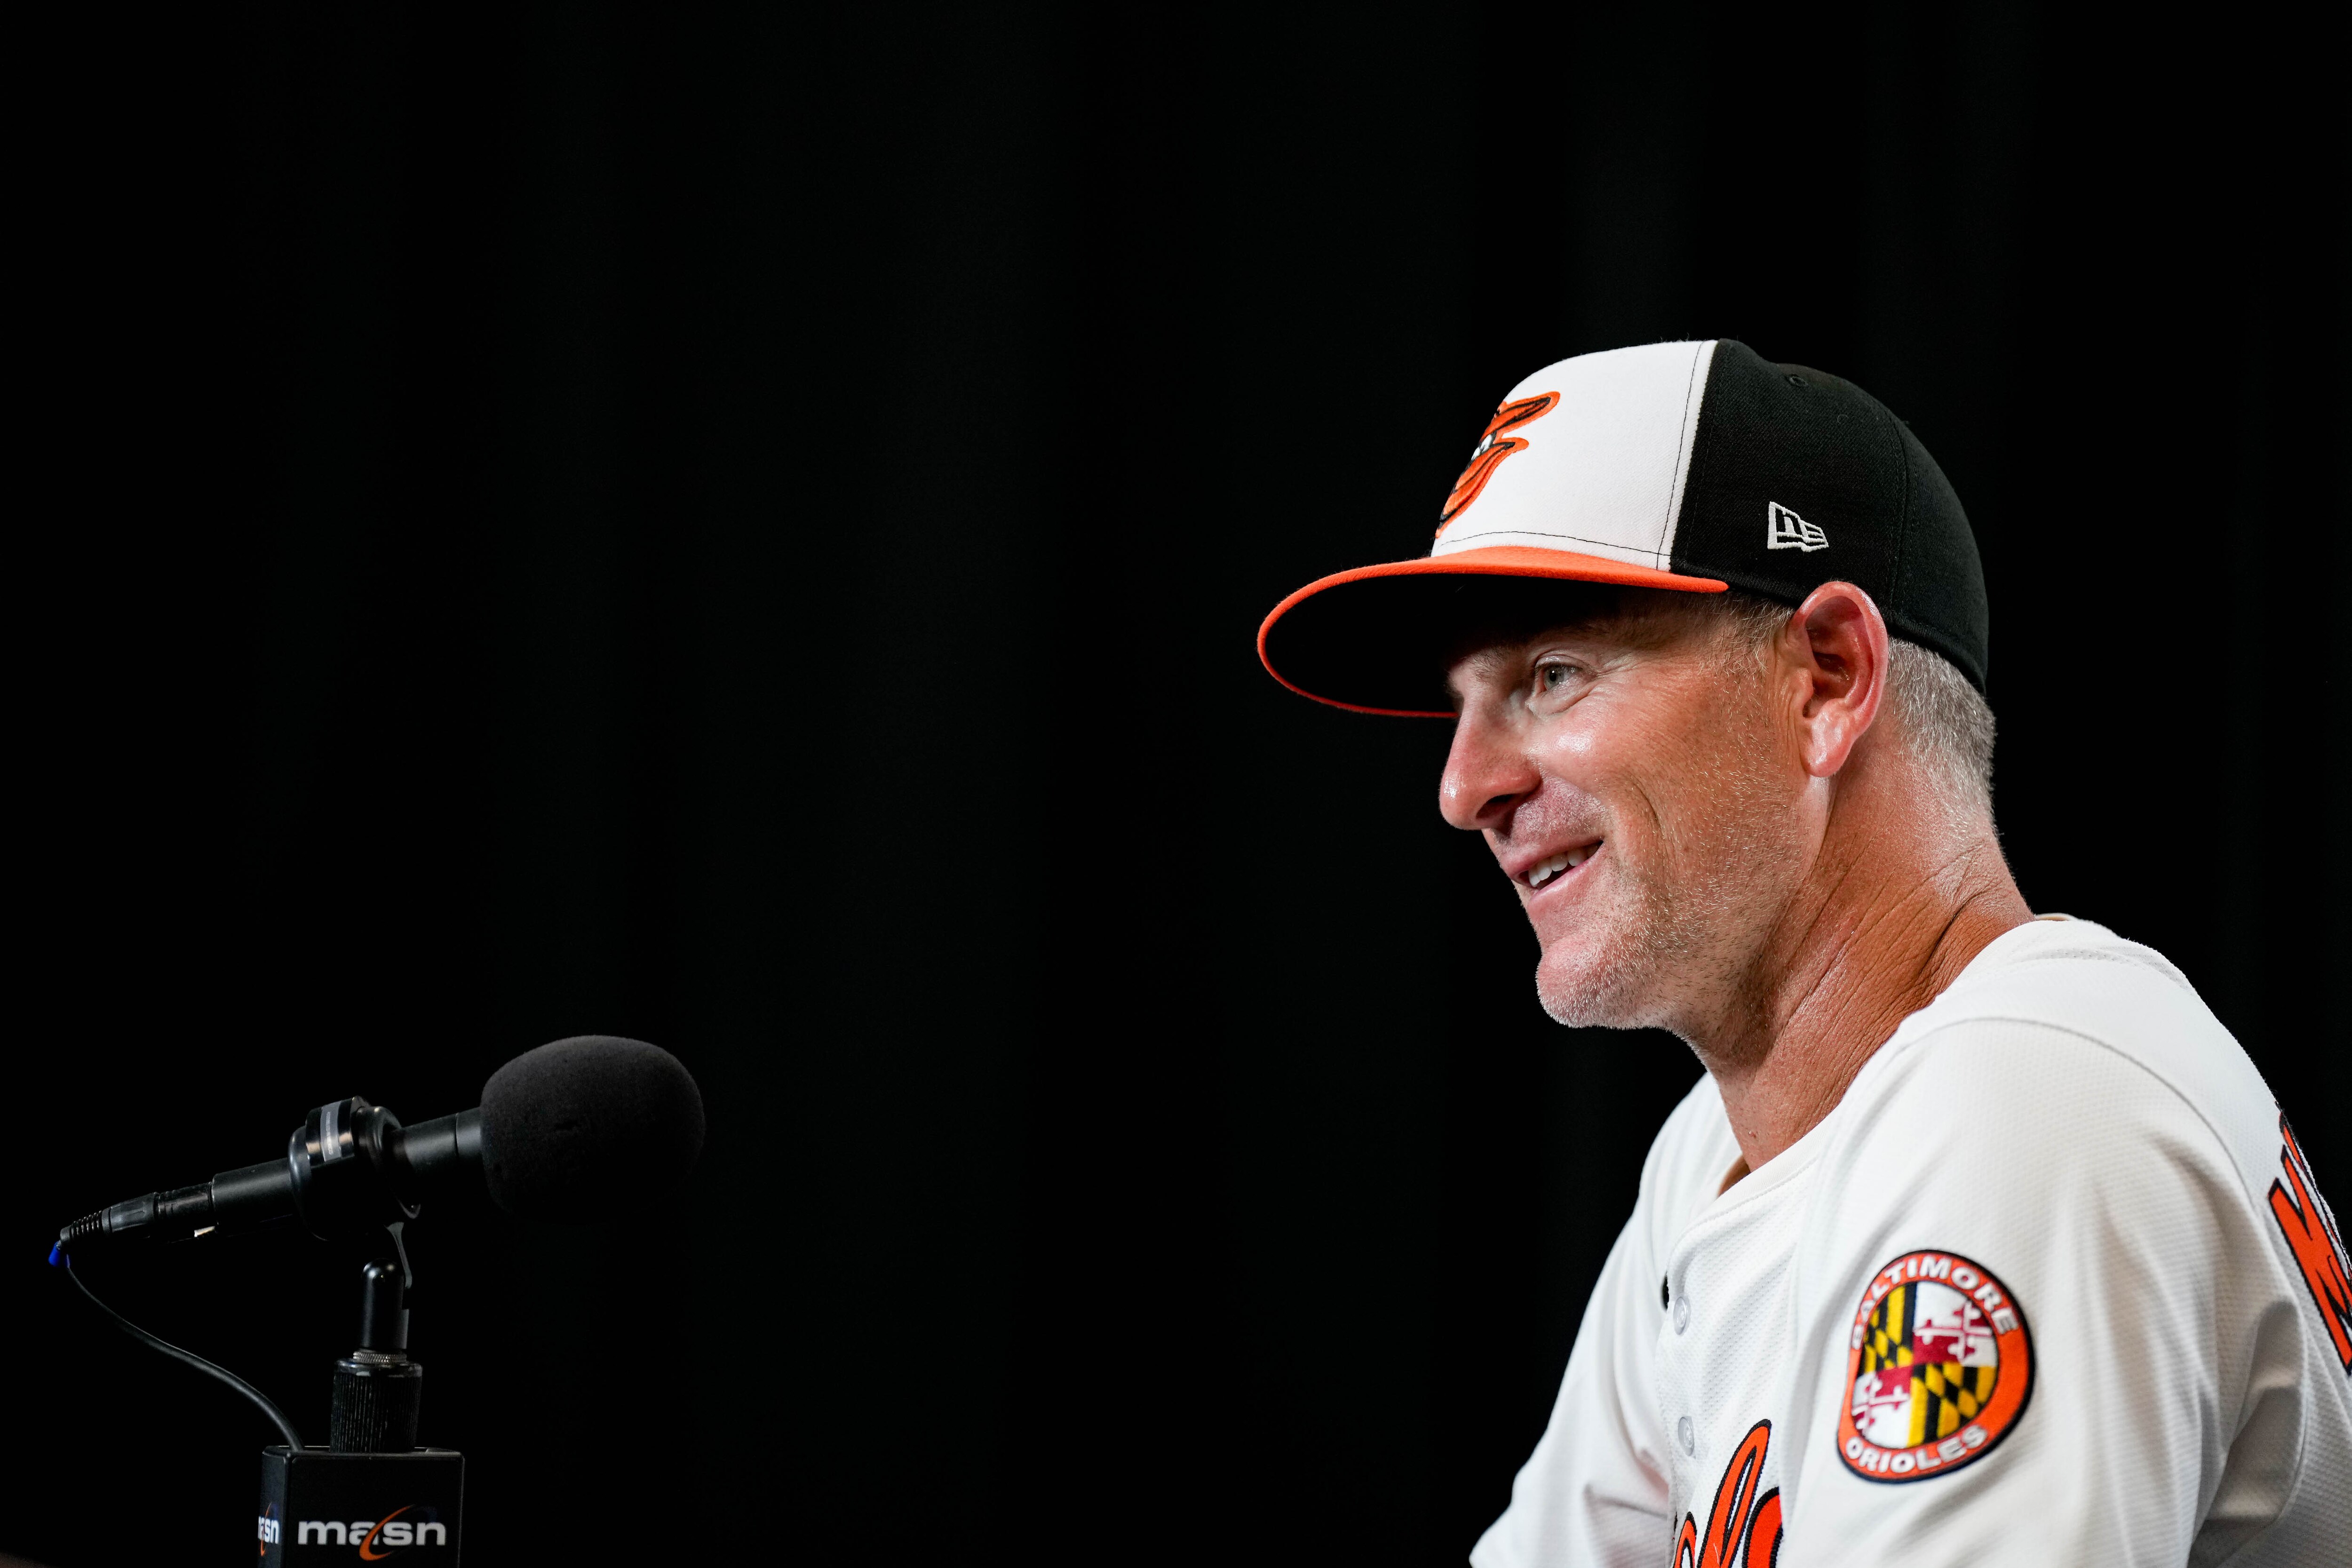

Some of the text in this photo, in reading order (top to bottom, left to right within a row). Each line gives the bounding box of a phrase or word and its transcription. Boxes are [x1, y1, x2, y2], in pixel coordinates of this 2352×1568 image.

[1851, 1256, 2019, 1350] BALTIMORE
[1845, 1425, 1988, 1473] ORIOLES
[297, 1520, 446, 1546] masn
